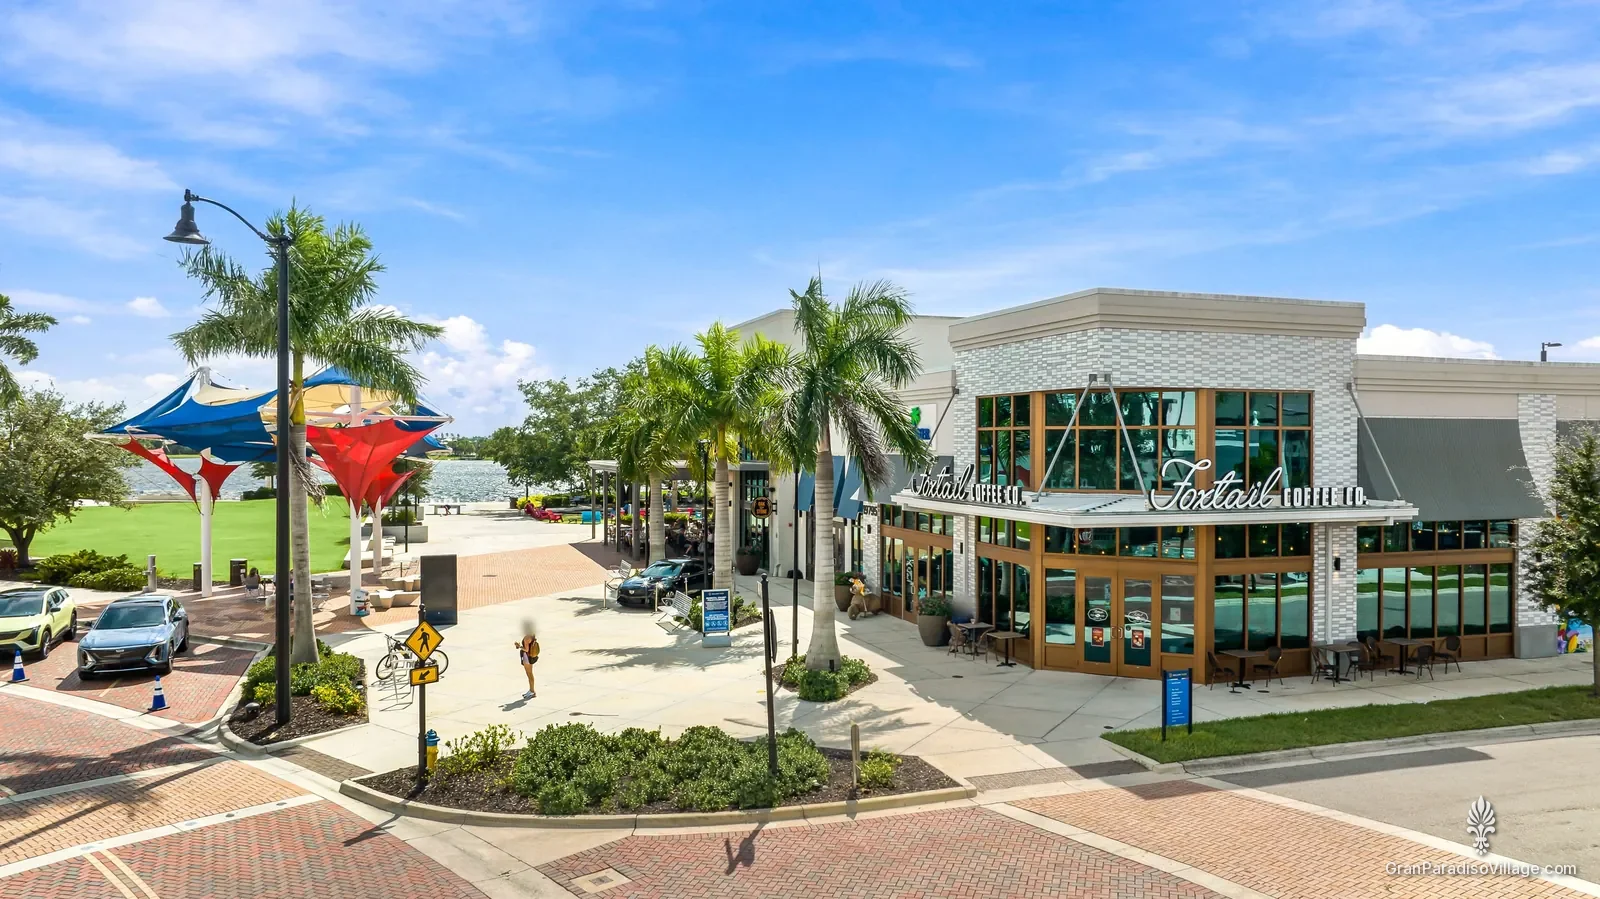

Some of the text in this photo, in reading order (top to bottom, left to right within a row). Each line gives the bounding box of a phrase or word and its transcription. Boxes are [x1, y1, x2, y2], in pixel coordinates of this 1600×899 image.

[971, 483, 1005, 504] COFFEE
[1150, 458, 1370, 510] Foxtail COFFEE CO.
